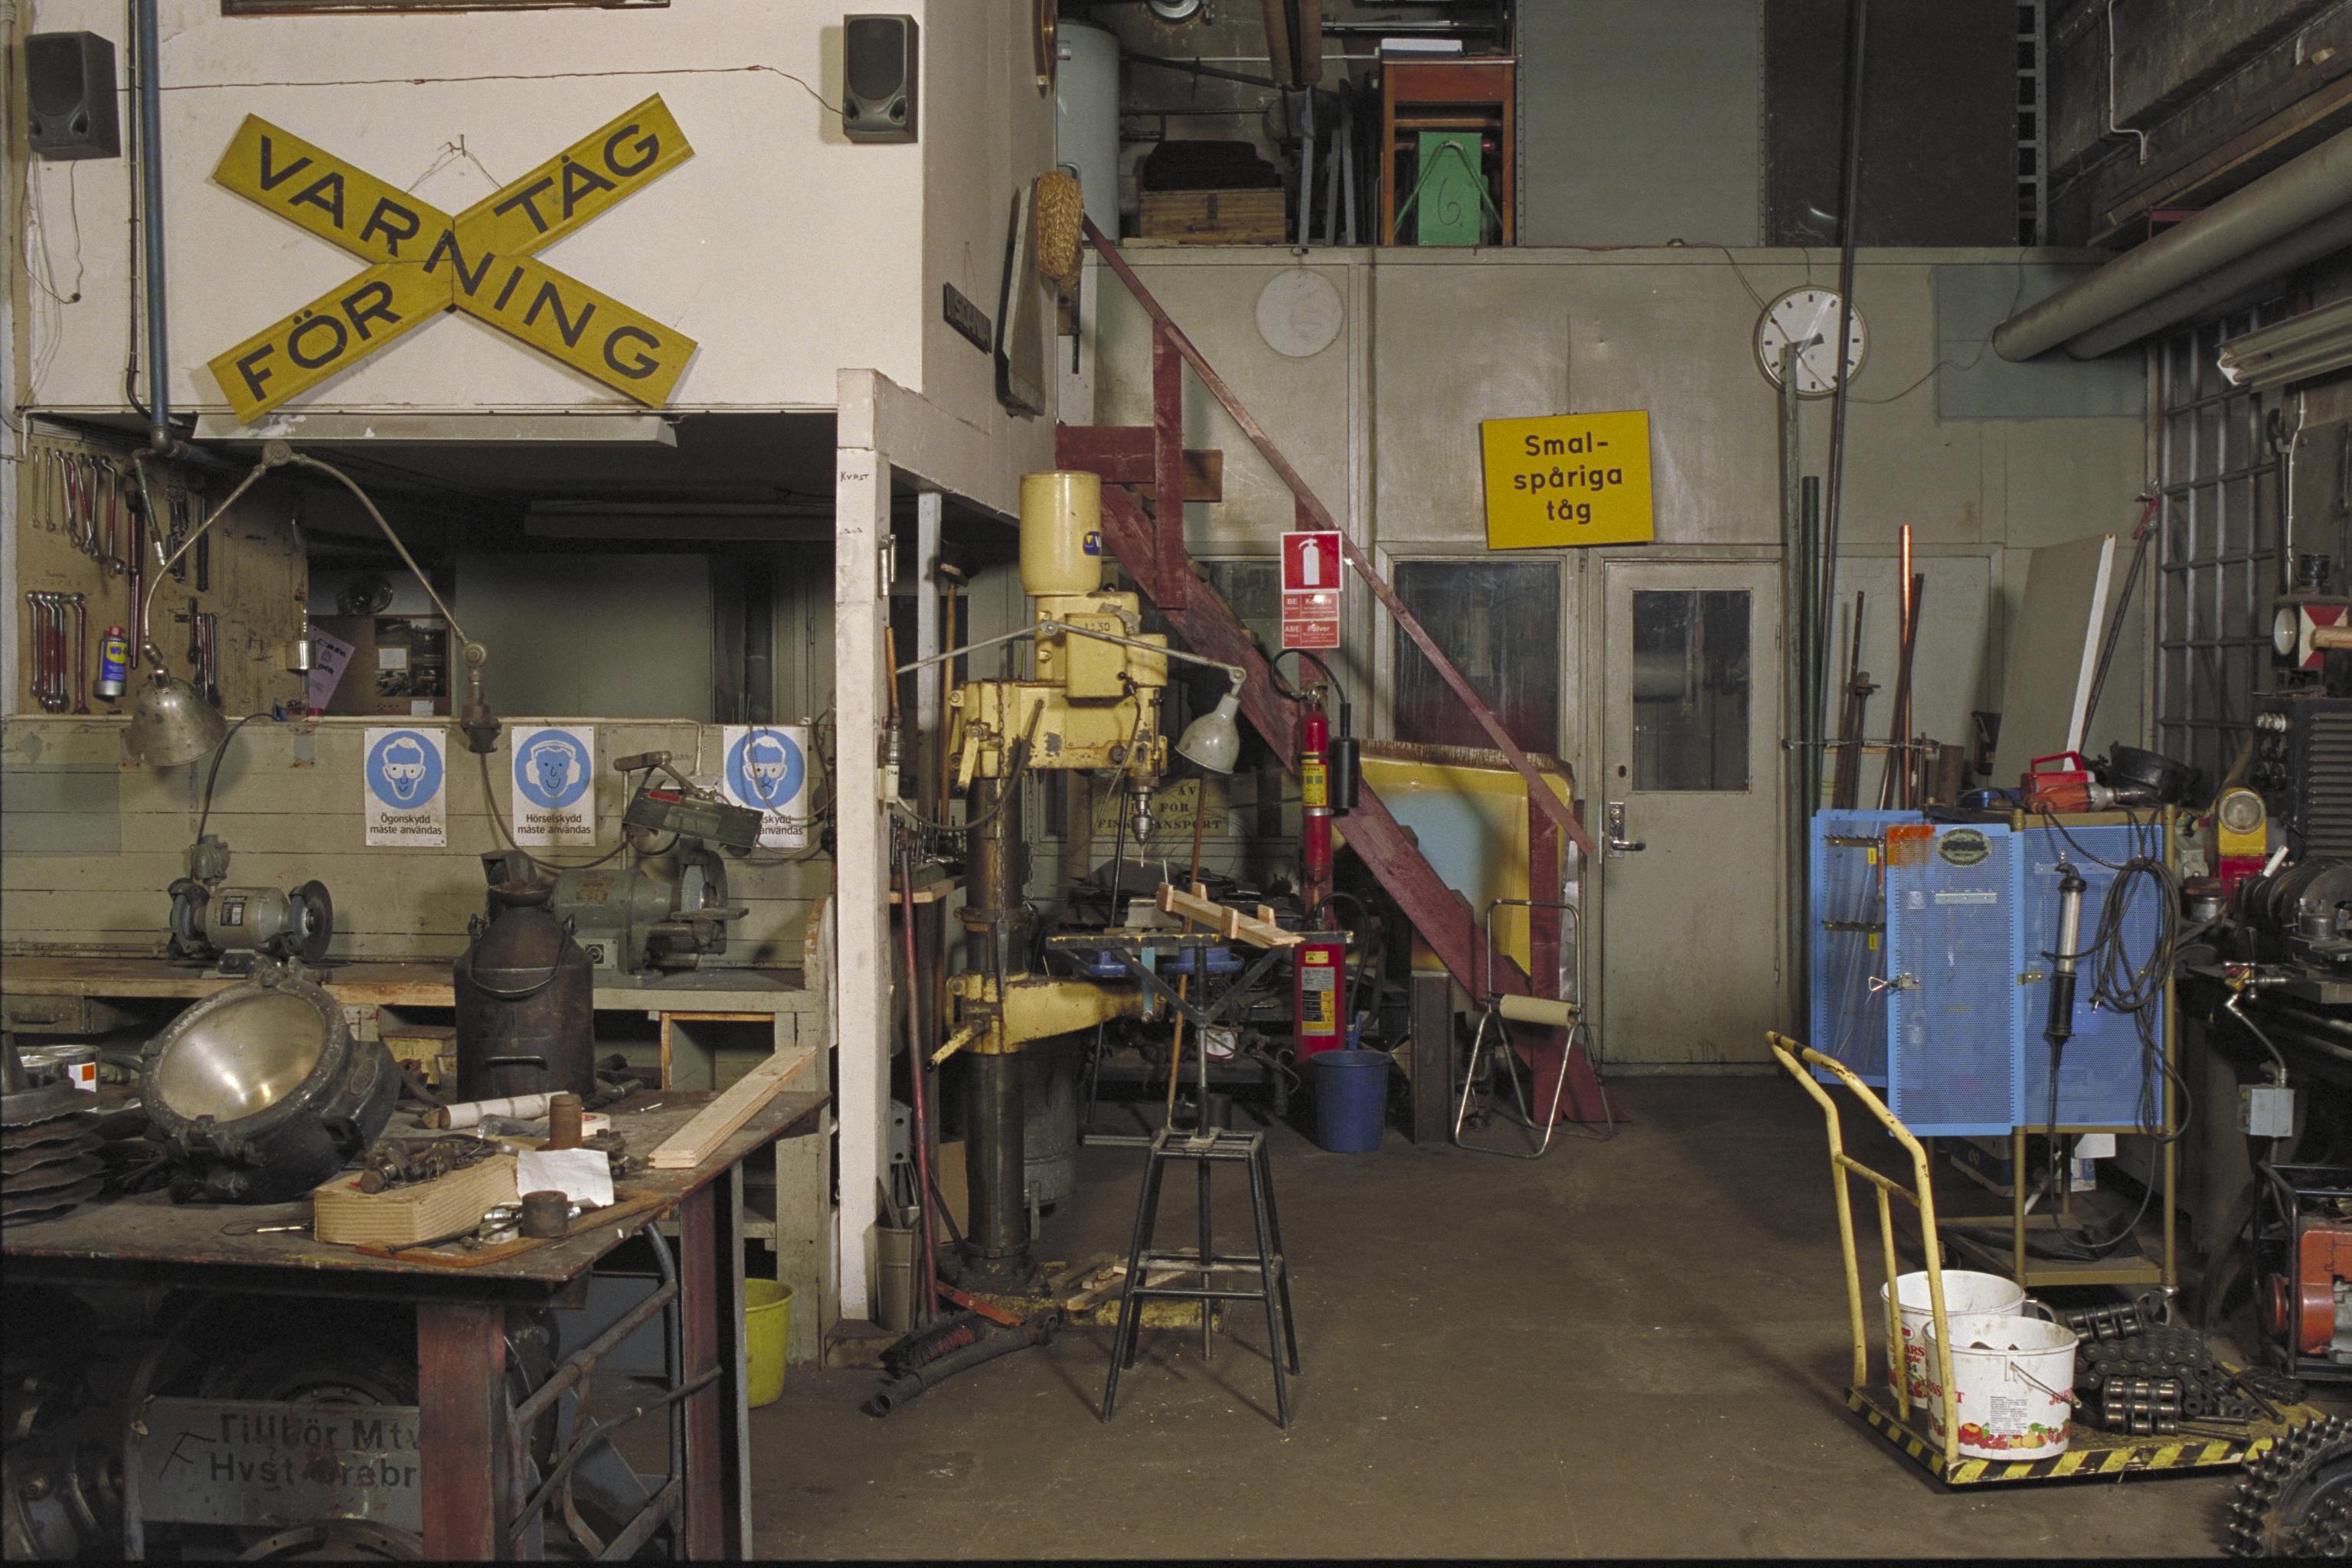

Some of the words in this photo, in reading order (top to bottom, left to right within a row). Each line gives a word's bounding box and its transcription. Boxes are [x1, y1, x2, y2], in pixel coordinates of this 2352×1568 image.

[494, 124, 660, 234] TÅG
[260, 135, 660, 380] VARNING
[236, 281, 402, 402] FÖR
[1525, 431, 1609, 456] Smal-
[1514, 465, 1622, 495] spåriga
[1547, 498, 1591, 525] tåg
[370, 824, 397, 834] måste
[400, 825, 443, 835] användas
[381, 812, 430, 825] Ögonskydd
[518, 824, 546, 834] måste
[548, 825, 592, 835] användas
[526, 813, 582, 825] Hörselskydd
[760, 825, 803, 835] användas
